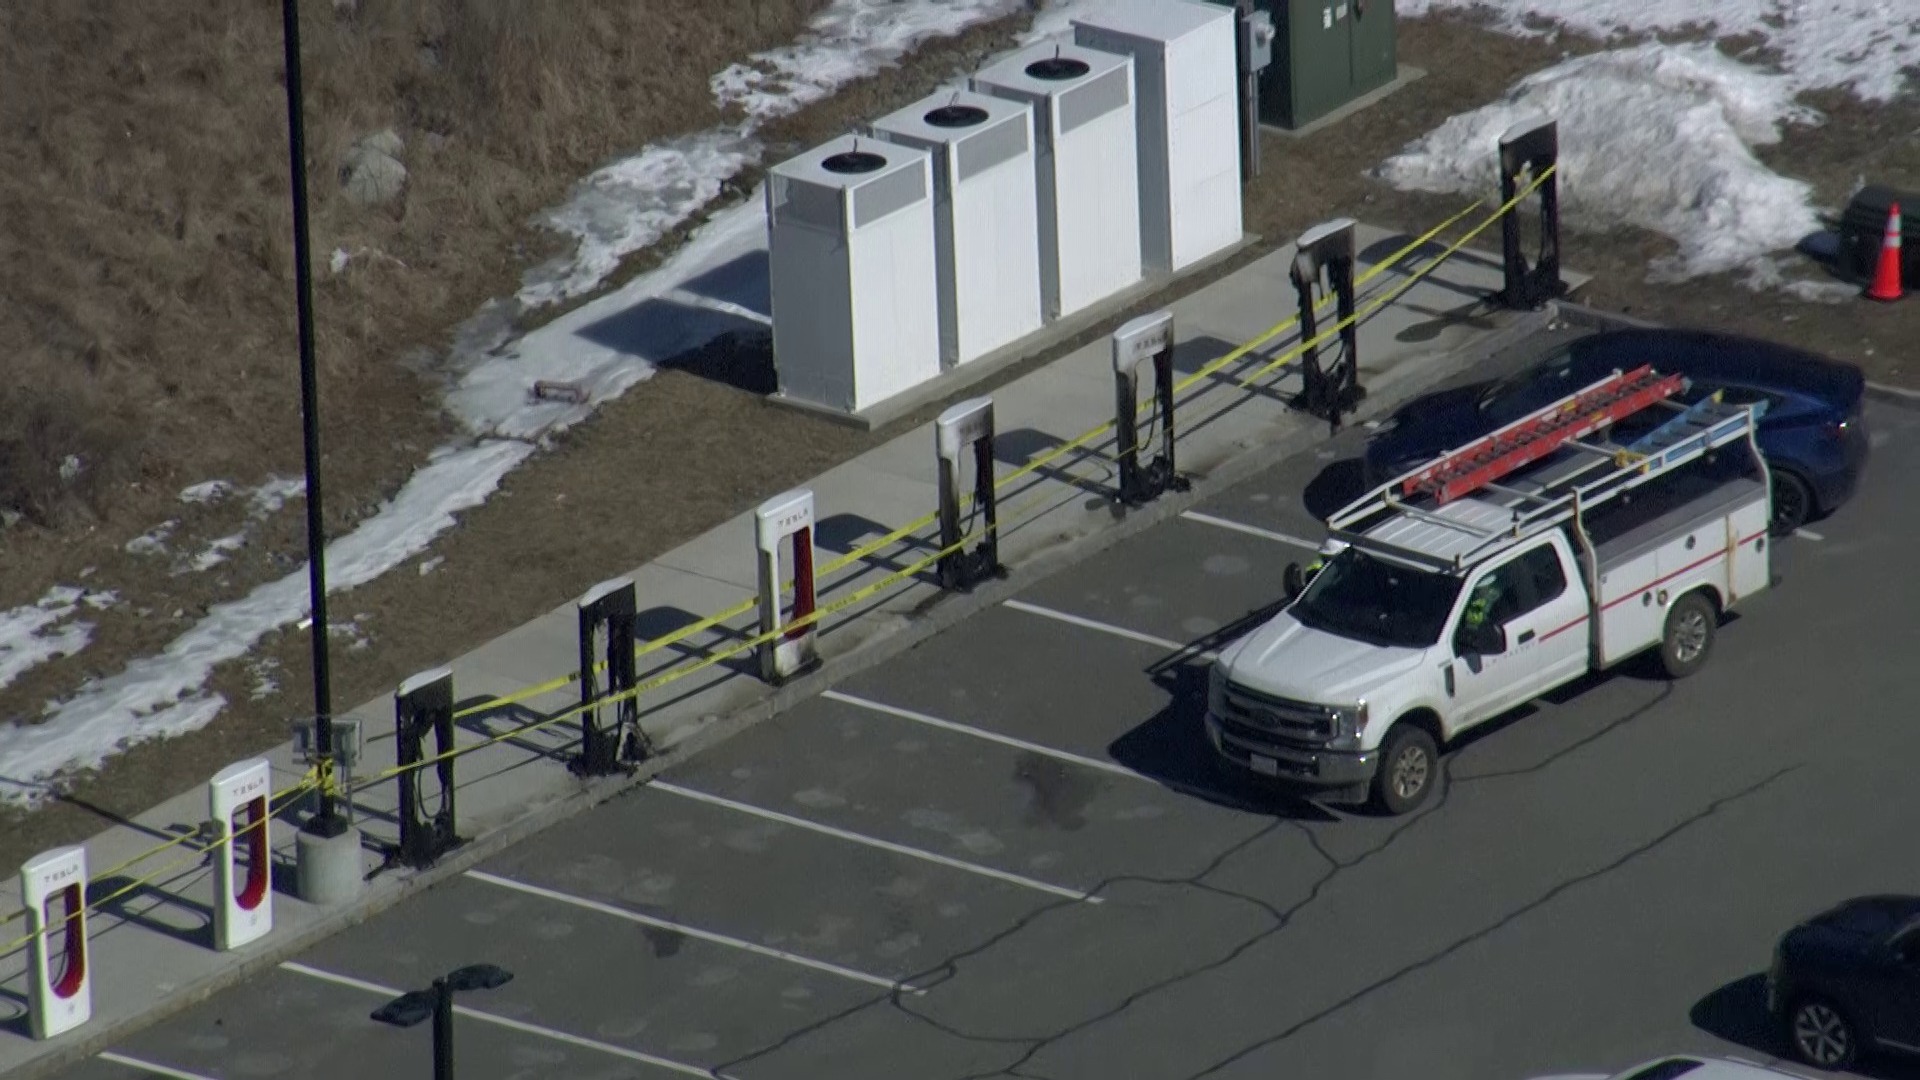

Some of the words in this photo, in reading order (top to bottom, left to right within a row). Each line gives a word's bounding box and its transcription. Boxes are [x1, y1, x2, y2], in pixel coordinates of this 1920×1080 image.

[778, 508, 808, 527] TESLA
[233, 776, 264, 795] TESLA
[44, 864, 78, 883] TESLA
